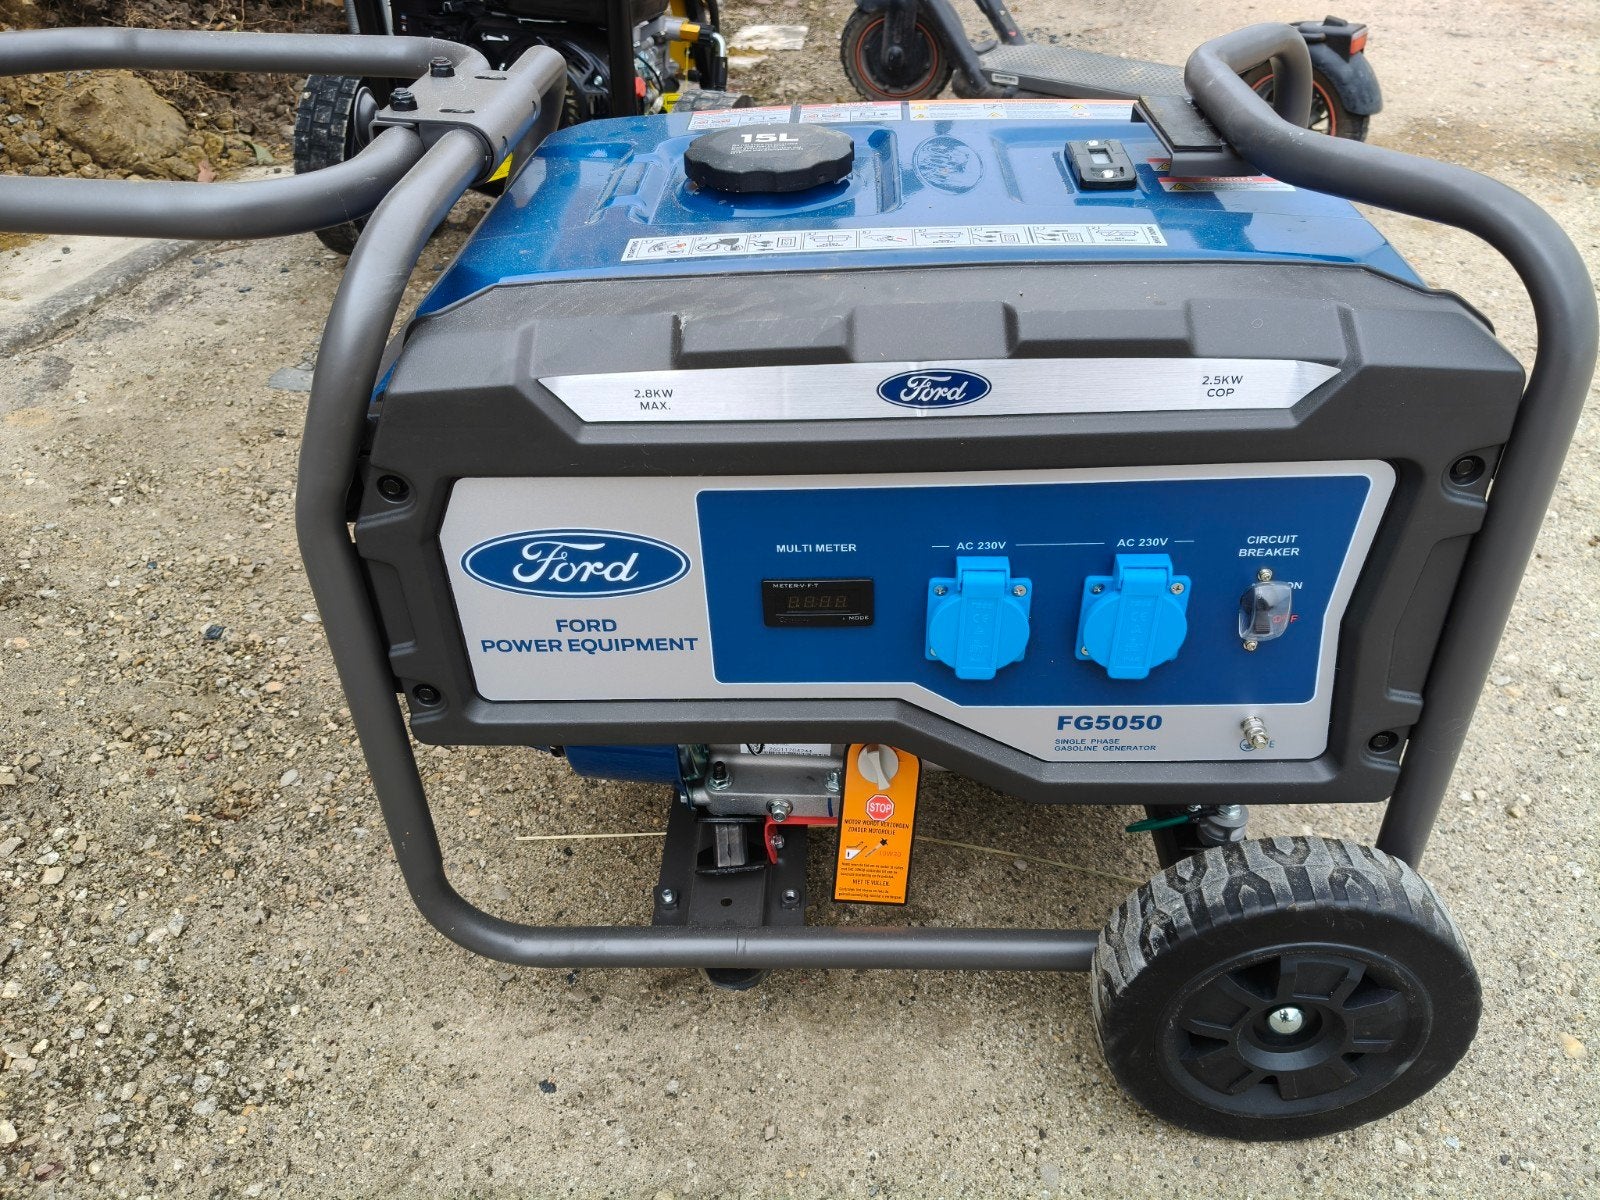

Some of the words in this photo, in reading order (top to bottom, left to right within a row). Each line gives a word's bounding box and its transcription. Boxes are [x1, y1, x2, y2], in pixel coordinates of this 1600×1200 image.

[741, 133, 799, 143] 15L
[1202, 375, 1244, 385] 2.5KW
[634, 389, 673, 398] 2.8KW
[900, 376, 968, 402] Ford
[1207, 388, 1235, 397] COP
[640, 401, 671, 410] MAX.
[1117, 539, 1135, 547] AC
[1137, 538, 1169, 547] 230V
[1247, 535, 1298, 544] CIRCUIT
[776, 544, 812, 553] MULTI
[815, 543, 857, 552] METER
[956, 542, 975, 550] AC
[977, 541, 1007, 550] 230V
[1239, 547, 1300, 557] BREAKER
[512, 541, 639, 583] Ford
[556, 619, 617, 632] FORD
[481, 639, 562, 653] POWER
[567, 637, 698, 655] EQUIPMENT
[1056, 715, 1163, 731] FG5050
[1102, 744, 1157, 752] GENERATOR
[869, 802, 892, 813] STOP
